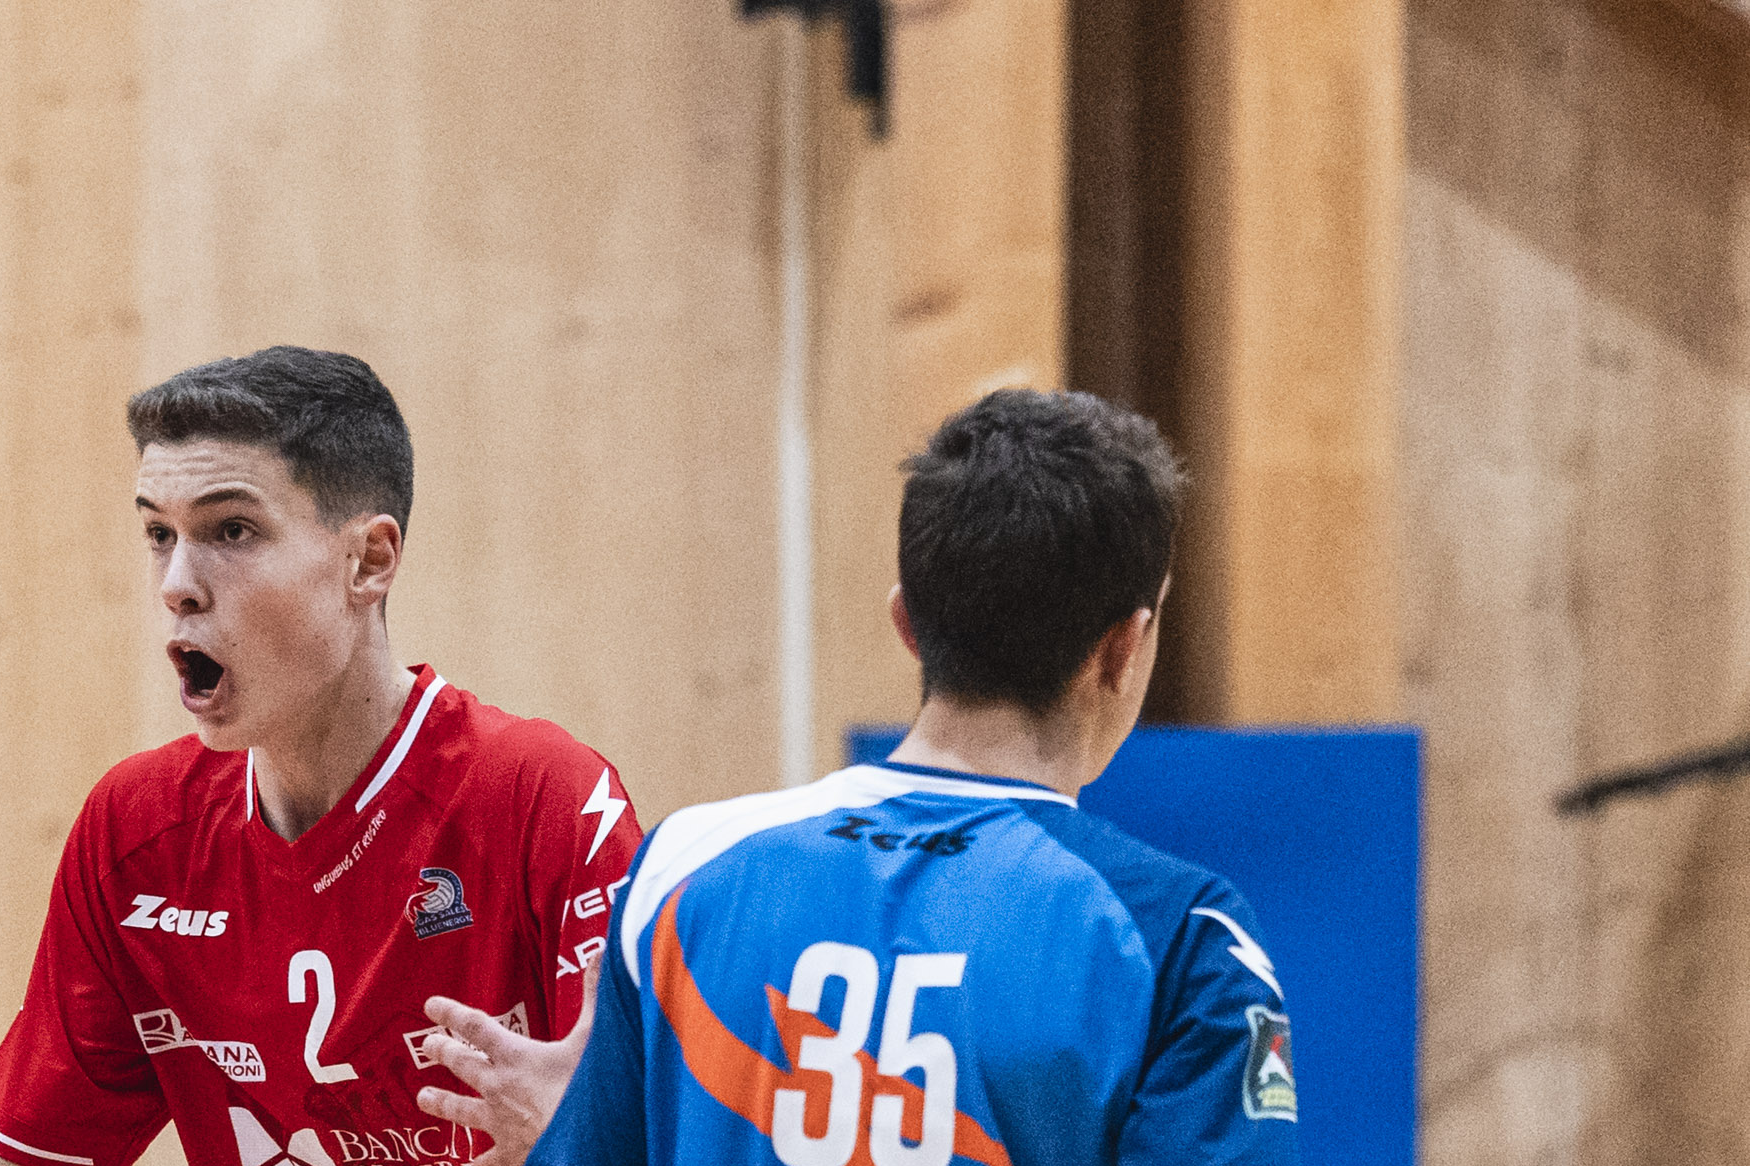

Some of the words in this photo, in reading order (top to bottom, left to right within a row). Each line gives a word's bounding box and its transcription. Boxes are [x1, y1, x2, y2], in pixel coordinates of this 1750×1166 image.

[351, 841, 364, 861] ET
[120, 894, 229, 937] Zeus
[287, 949, 359, 1084] 2
